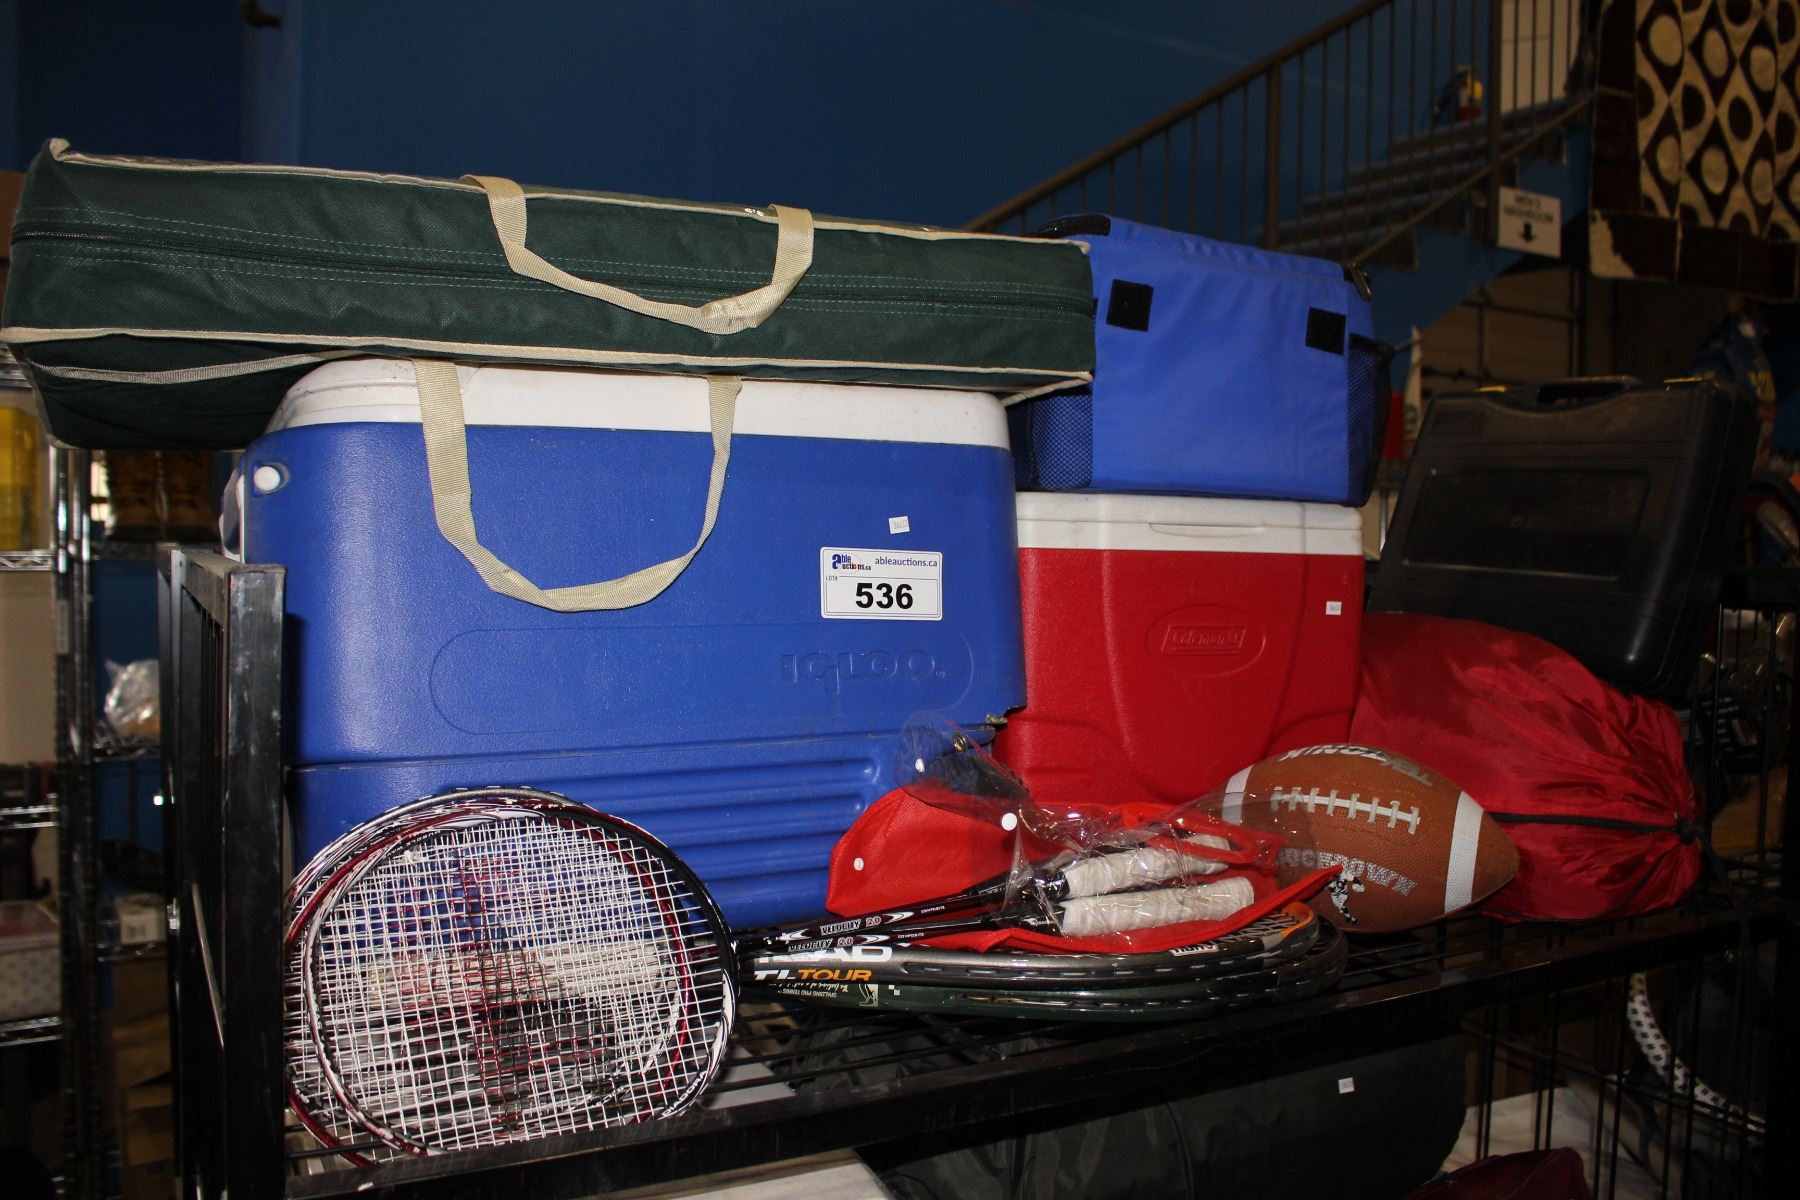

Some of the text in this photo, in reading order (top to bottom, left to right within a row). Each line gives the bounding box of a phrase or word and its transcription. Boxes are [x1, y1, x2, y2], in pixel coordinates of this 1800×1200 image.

[874, 556, 938, 568] ableauctions.ca
[855, 582, 914, 610] 536
[820, 919, 861, 936] VELOCITY
[662, 1071, 707, 1116] DIADORA
